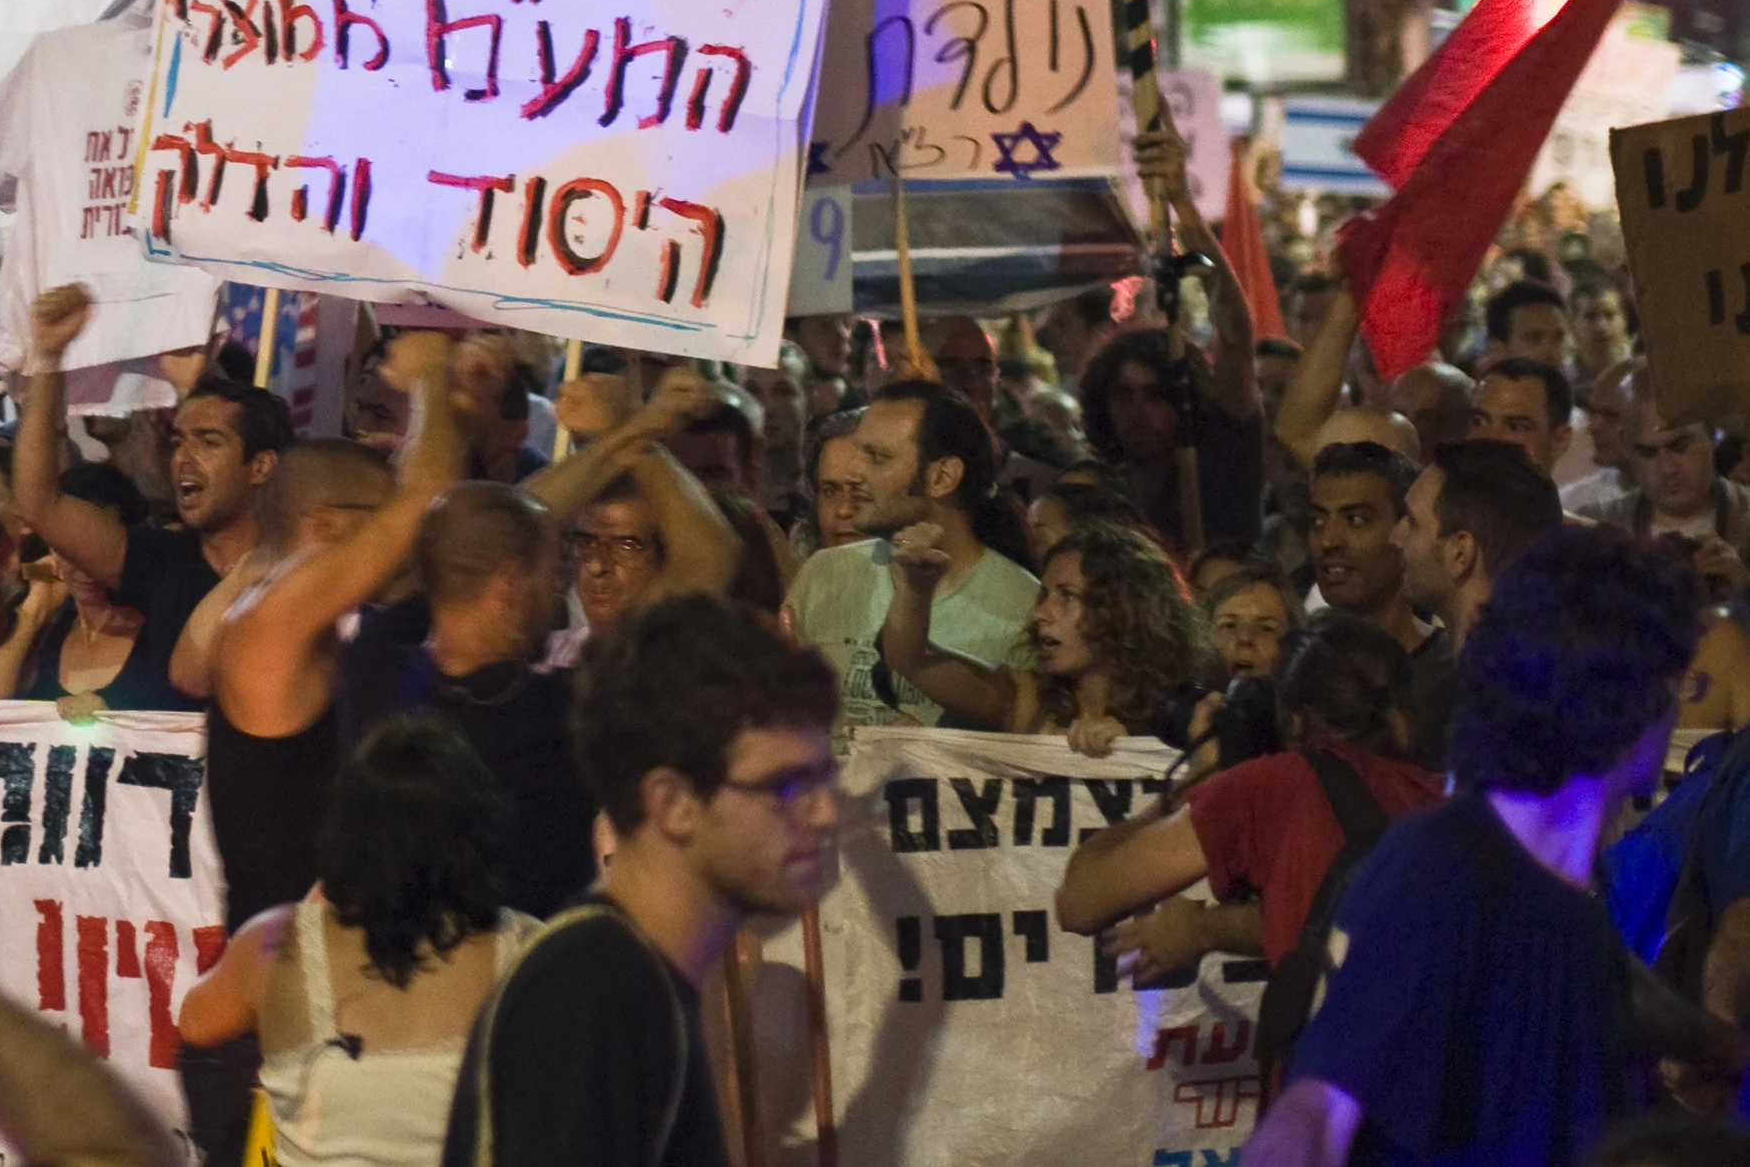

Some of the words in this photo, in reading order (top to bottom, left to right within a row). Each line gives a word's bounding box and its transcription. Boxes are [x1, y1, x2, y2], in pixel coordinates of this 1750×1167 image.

[151, 119, 372, 244] והדלק
[427, 170, 724, 309] היסוד
[884, 774, 1168, 853] צמצם
